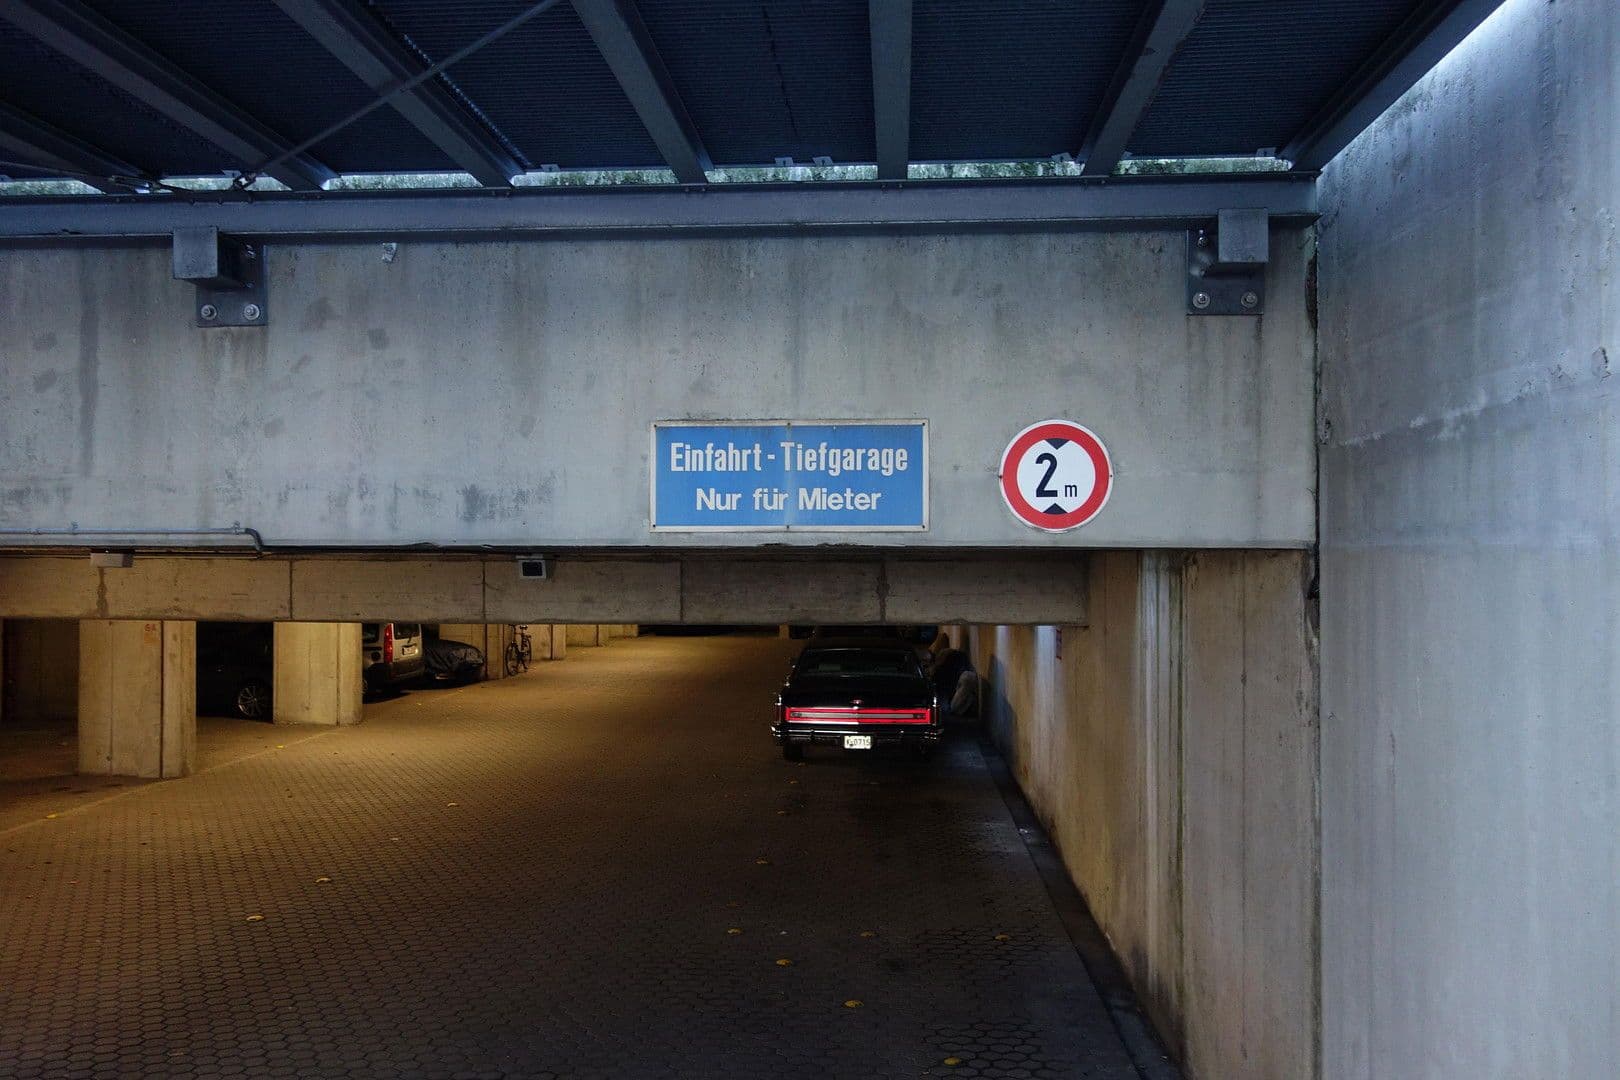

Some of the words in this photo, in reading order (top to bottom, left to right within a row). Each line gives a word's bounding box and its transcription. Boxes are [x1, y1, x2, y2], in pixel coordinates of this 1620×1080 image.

[670, 442, 762, 472] Einfahrt
[780, 441, 908, 477] Tiefgarage
[1035, 452, 1058, 498] 2
[1064, 484, 1078, 498] m
[696, 487, 742, 511] Nur
[752, 487, 790, 511] für
[798, 487, 882, 511] Mieter
